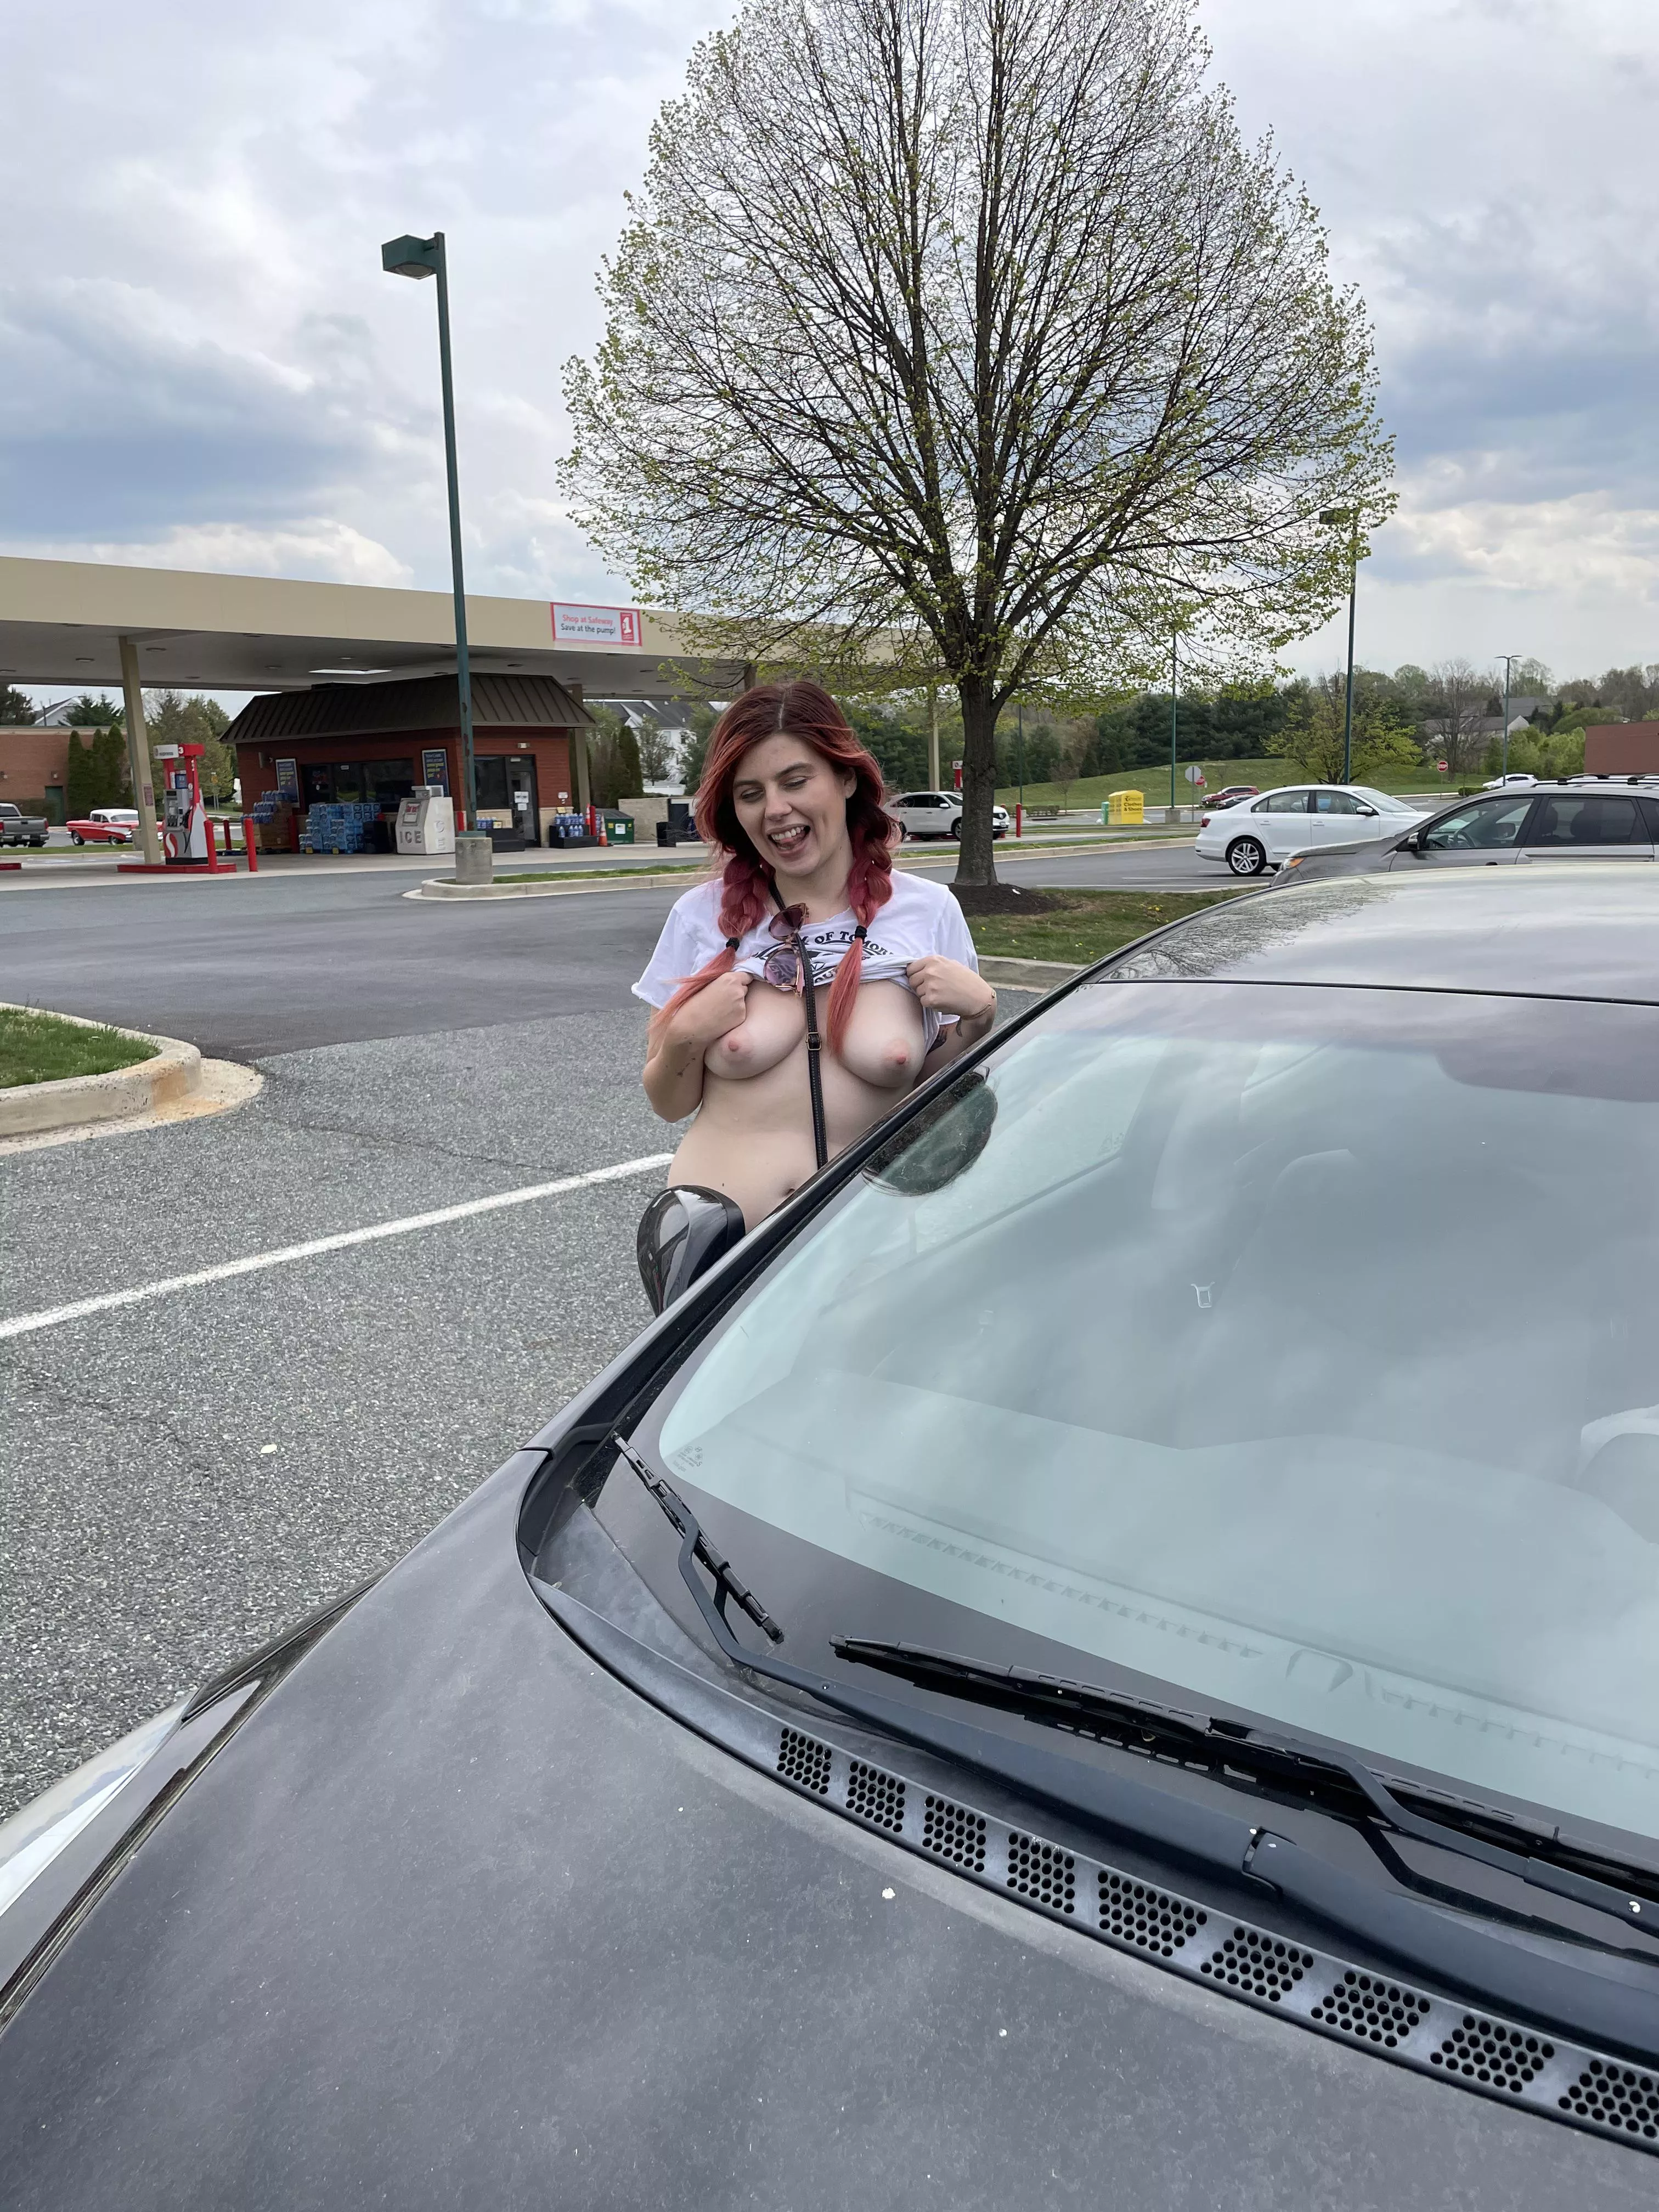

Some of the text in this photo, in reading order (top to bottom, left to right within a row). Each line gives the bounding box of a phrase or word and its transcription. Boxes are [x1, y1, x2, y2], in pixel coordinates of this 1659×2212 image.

[562, 614, 579, 624] Shop
[588, 617, 613, 627] Safeway
[596, 627, 616, 635] pump!
[399, 831, 422, 844] ICE
[814, 932, 834, 944] OF
